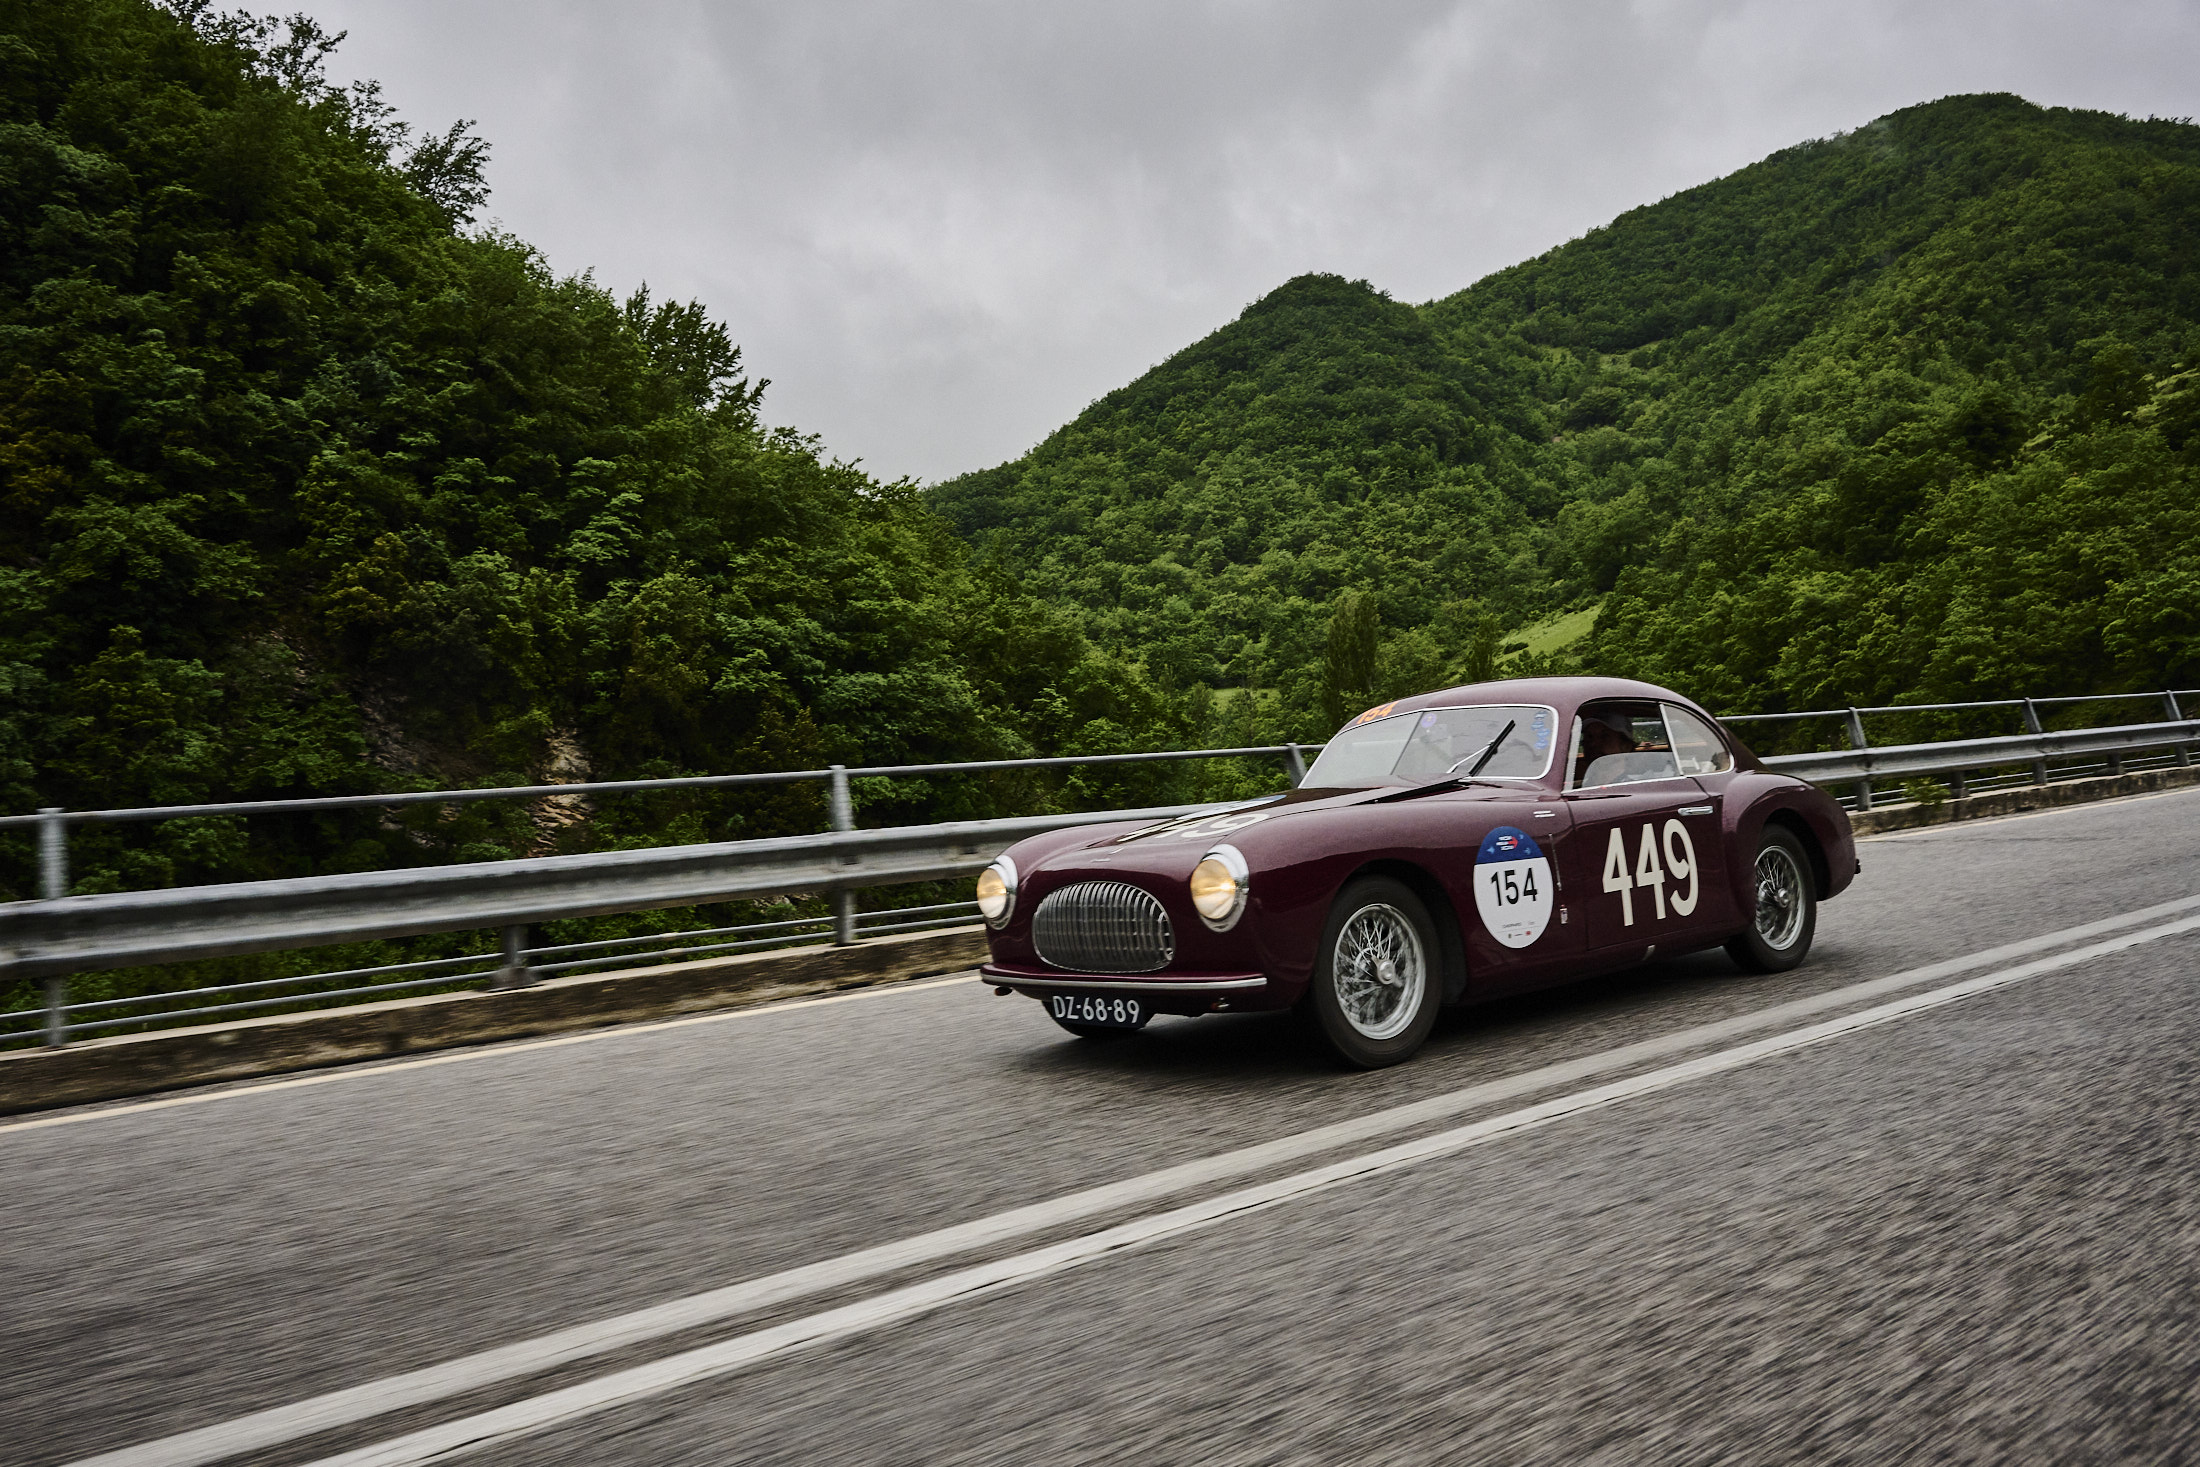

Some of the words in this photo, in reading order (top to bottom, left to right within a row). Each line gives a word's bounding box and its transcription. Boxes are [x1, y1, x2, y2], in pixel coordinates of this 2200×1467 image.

[1491, 867, 1538, 907] 154
[1602, 818, 1699, 927] 449
[1052, 995, 1140, 1024] DZ-68-89
